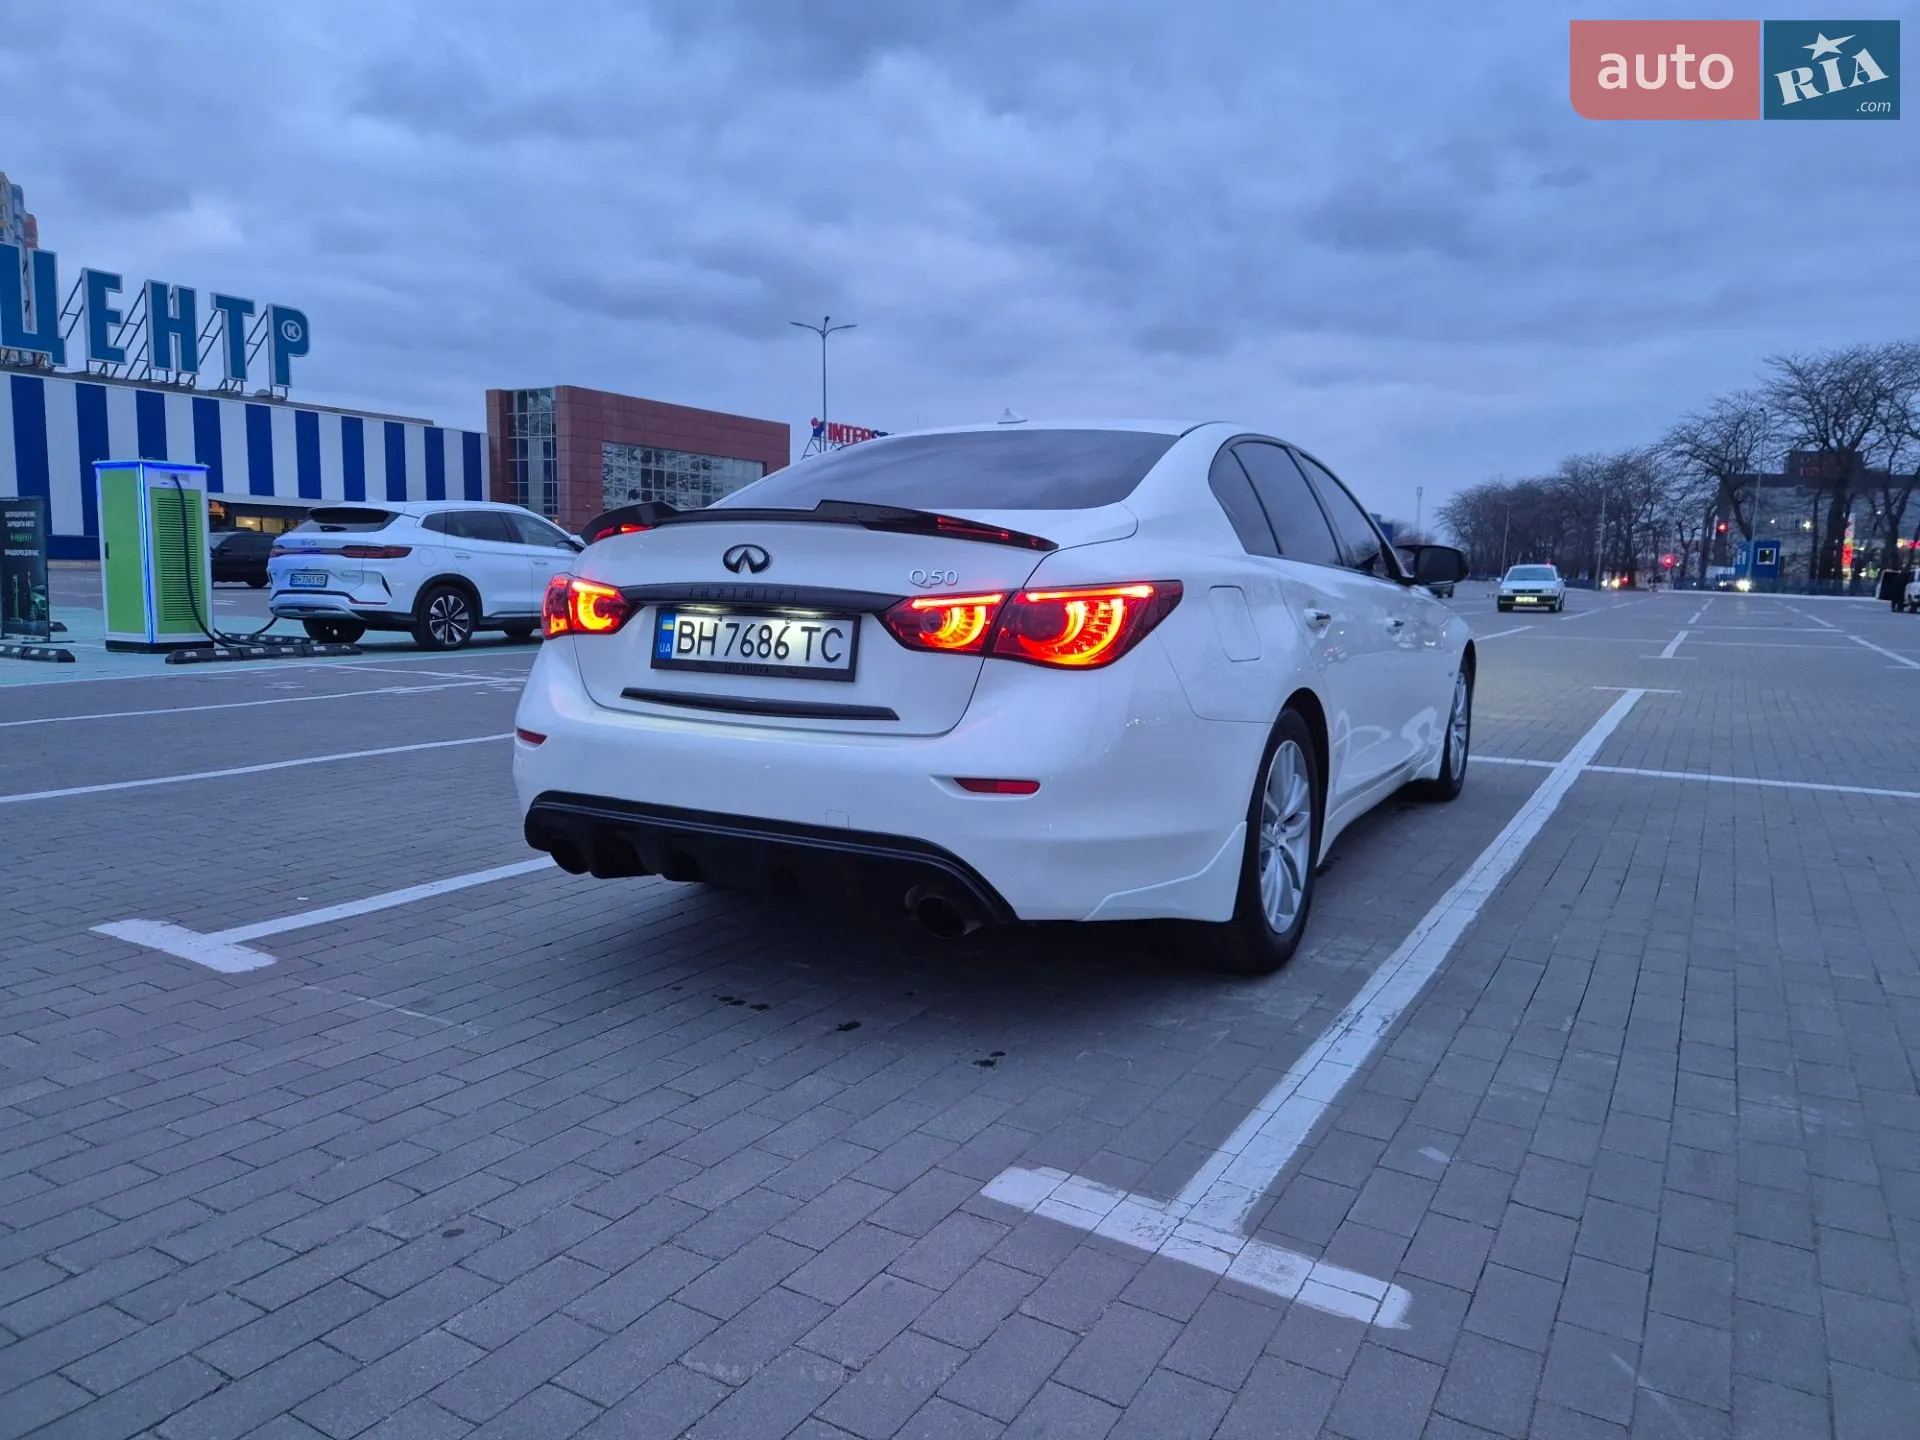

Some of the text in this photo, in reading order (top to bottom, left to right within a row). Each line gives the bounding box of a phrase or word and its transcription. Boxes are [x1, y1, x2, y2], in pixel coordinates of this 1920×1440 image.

[0, 242, 310, 388] ЦЕНТР
[909, 569, 958, 589] Q50
[659, 643, 671, 654] UA
[676, 620, 844, 663] BH 7686 TC
